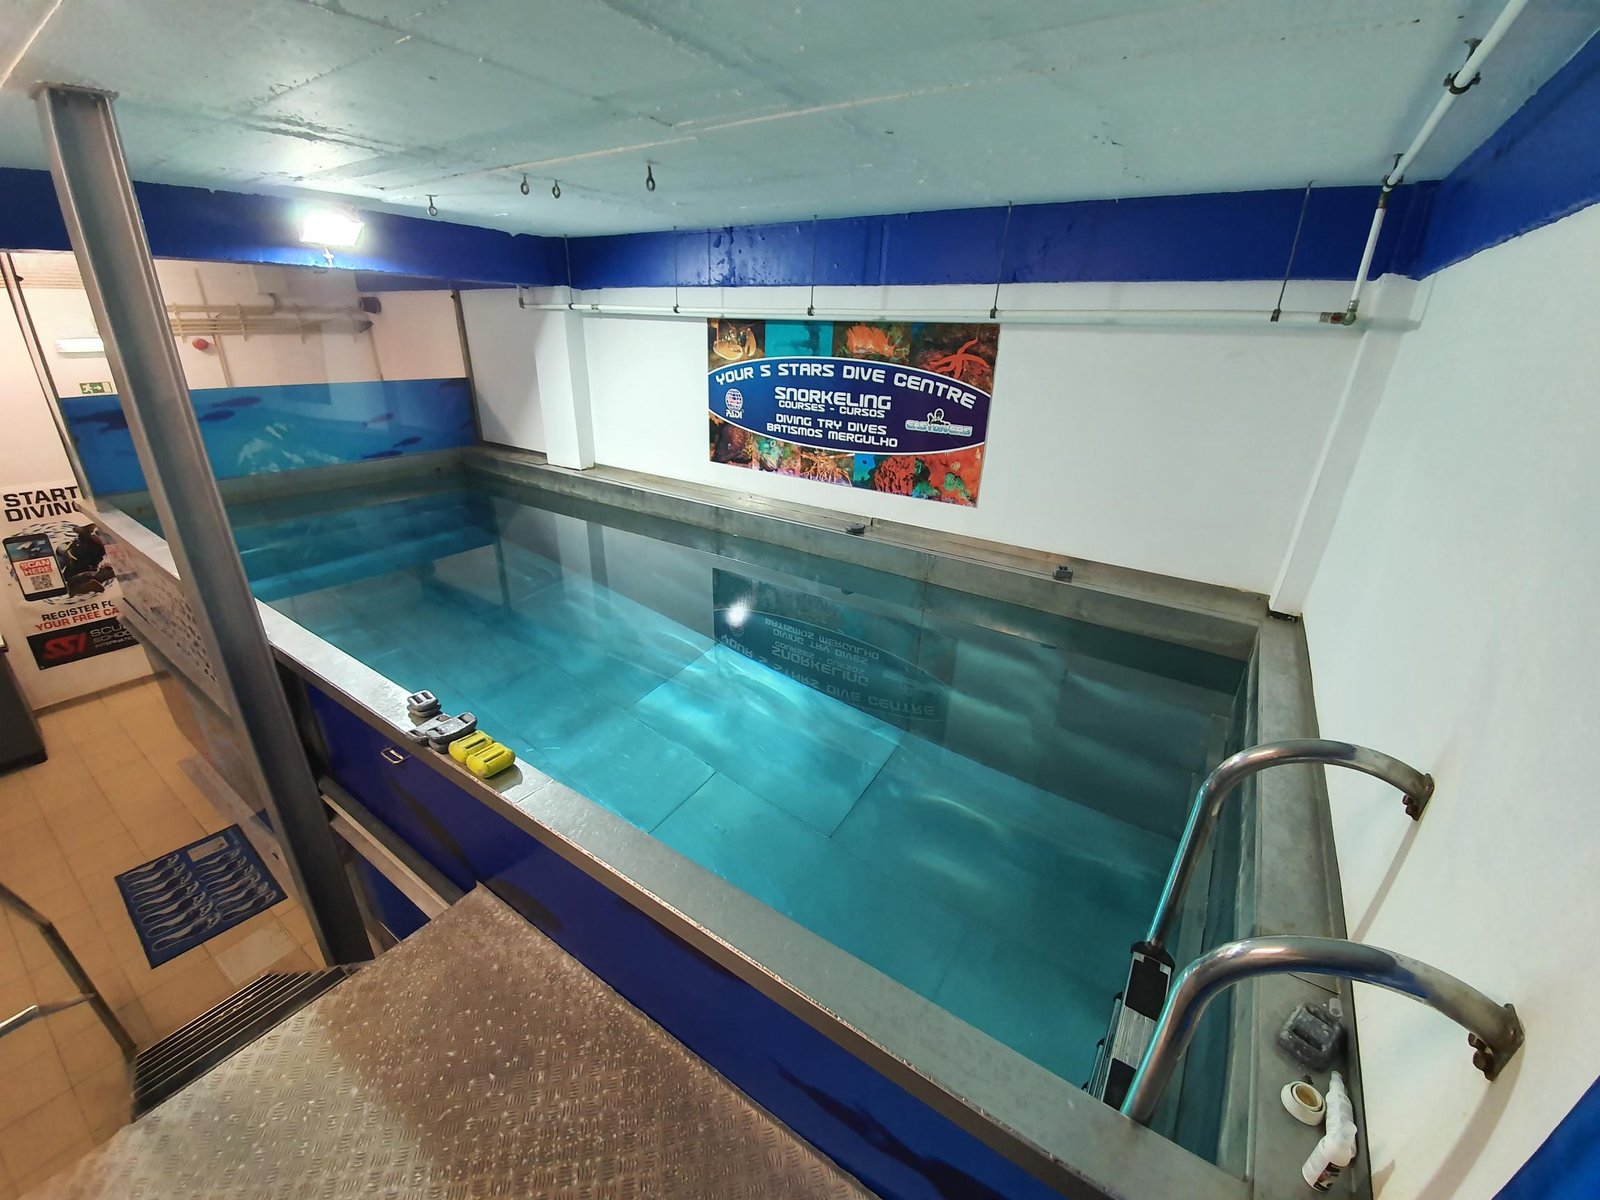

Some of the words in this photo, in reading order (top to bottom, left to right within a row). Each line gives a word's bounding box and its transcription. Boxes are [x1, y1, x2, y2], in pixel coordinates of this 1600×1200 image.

[716, 366, 754, 386] YOUR
[760, 364, 771, 378] 5
[778, 363, 835, 378] STARS
[842, 365, 886, 384] DIVE
[893, 372, 977, 410] CENTRE
[774, 386, 892, 411] SNORKELING
[725, 408, 743, 419] PADI
[778, 400, 826, 413] COURSES
[839, 406, 886, 419] CURSOS
[776, 413, 812, 428] DIVING
[817, 418, 842, 430] TRY
[847, 422, 888, 436] DIVES
[766, 422, 823, 438] BATISMOS
[828, 430, 898, 448] MERGULHO
[3, 485, 78, 507] START
[20, 558, 51, 570] SCAN
[24, 566, 53, 577] HERE
[41, 602, 99, 621] REGISTER
[35, 618, 71, 632] YOUR
[73, 612, 102, 624] FREE
[90, 624, 124, 637] SCU
